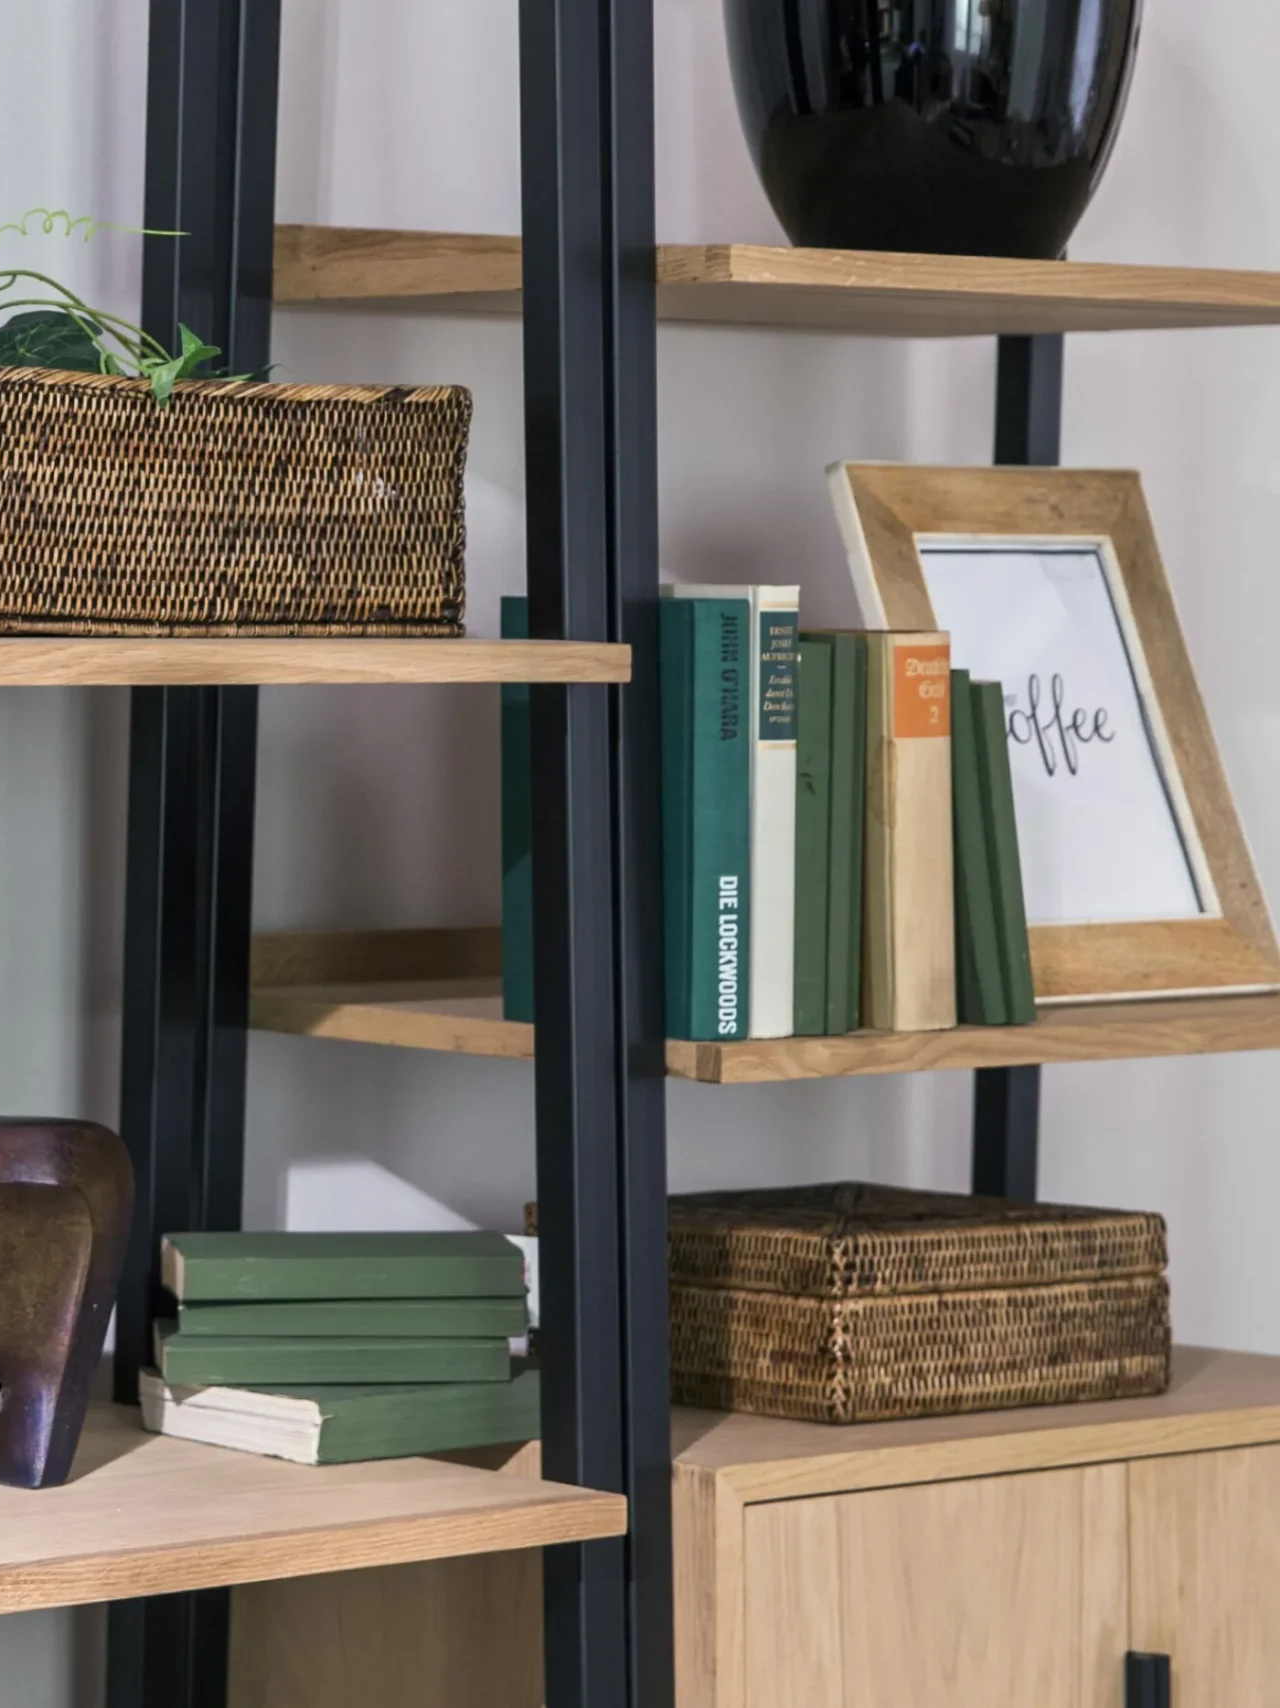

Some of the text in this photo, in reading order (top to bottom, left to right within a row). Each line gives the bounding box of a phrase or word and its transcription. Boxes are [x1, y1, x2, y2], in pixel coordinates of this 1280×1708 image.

[721, 612, 739, 740] JOHN O'HARA
[1007, 673, 1116, 777] offee
[718, 876, 738, 1035] DIE LOCKWOODS
